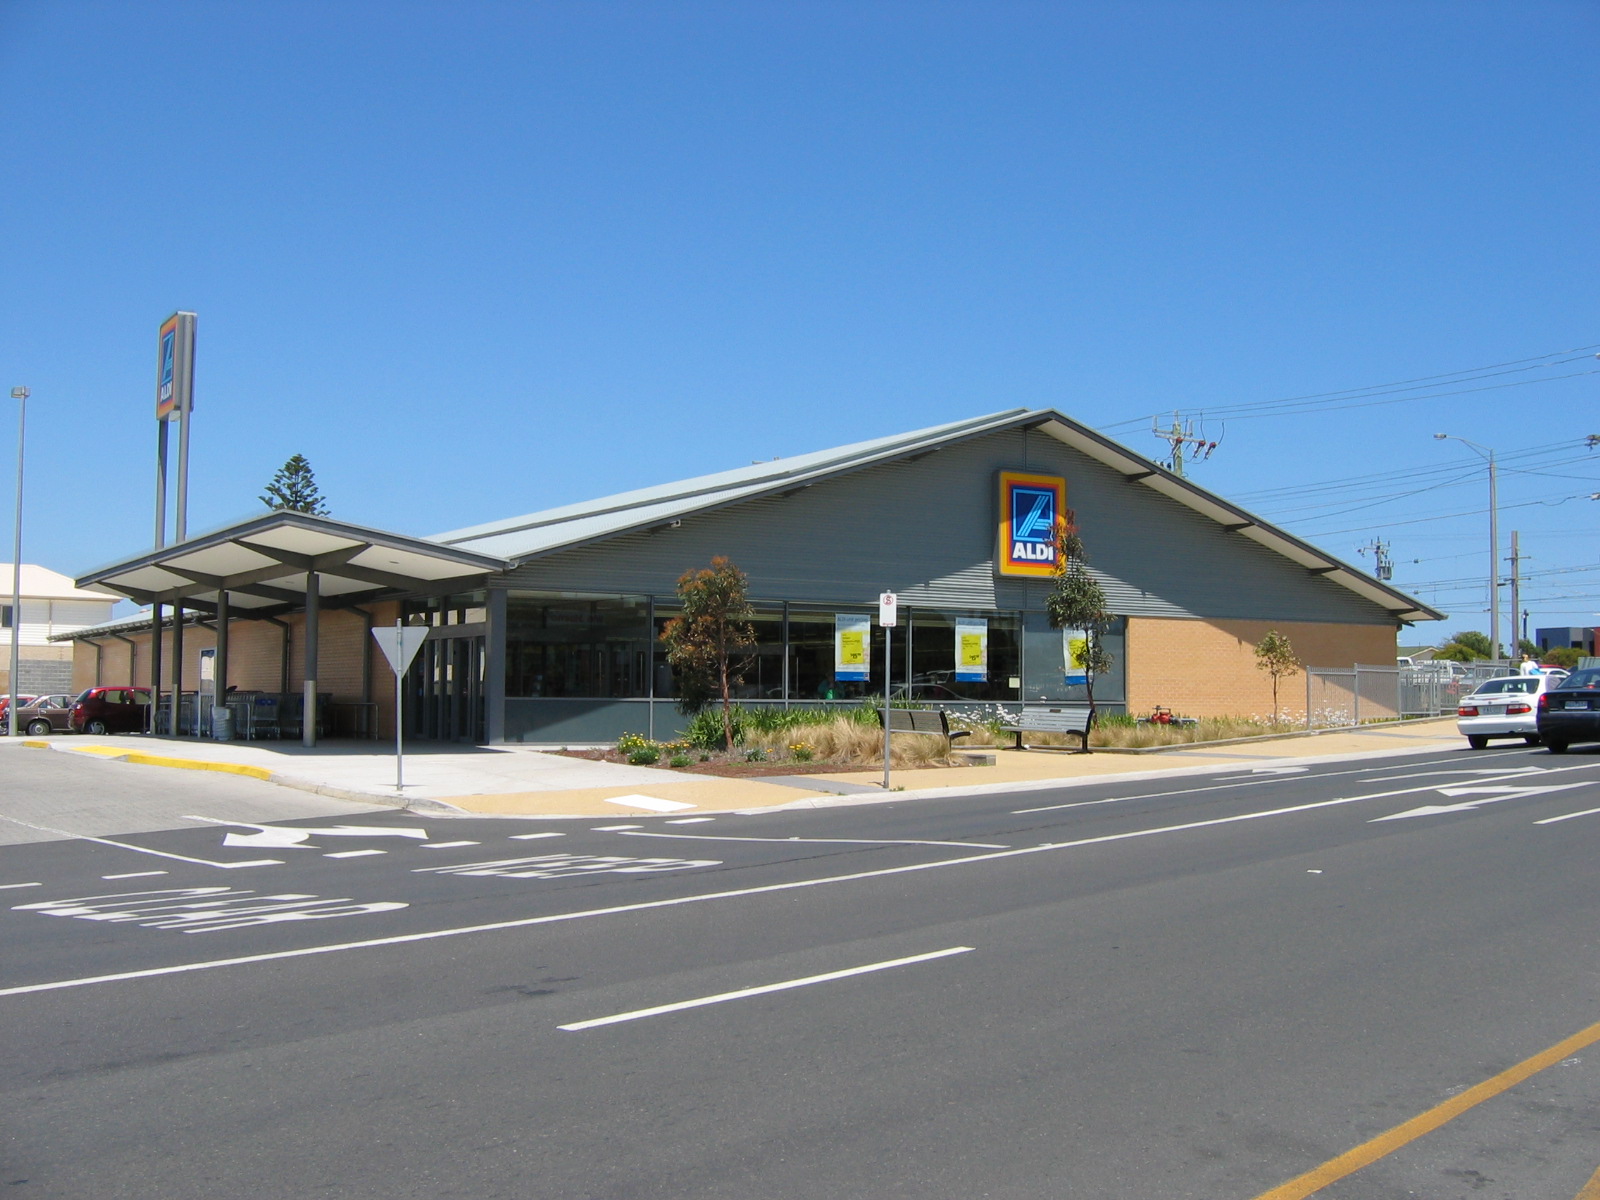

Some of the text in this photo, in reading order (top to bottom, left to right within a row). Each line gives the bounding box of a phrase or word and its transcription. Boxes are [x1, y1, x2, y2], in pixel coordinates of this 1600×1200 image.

[160, 381, 172, 402] ALDI
[1012, 542, 1054, 560] ALDI
[410, 853, 724, 880] KEEP
[10, 886, 410, 934] CLEAR
